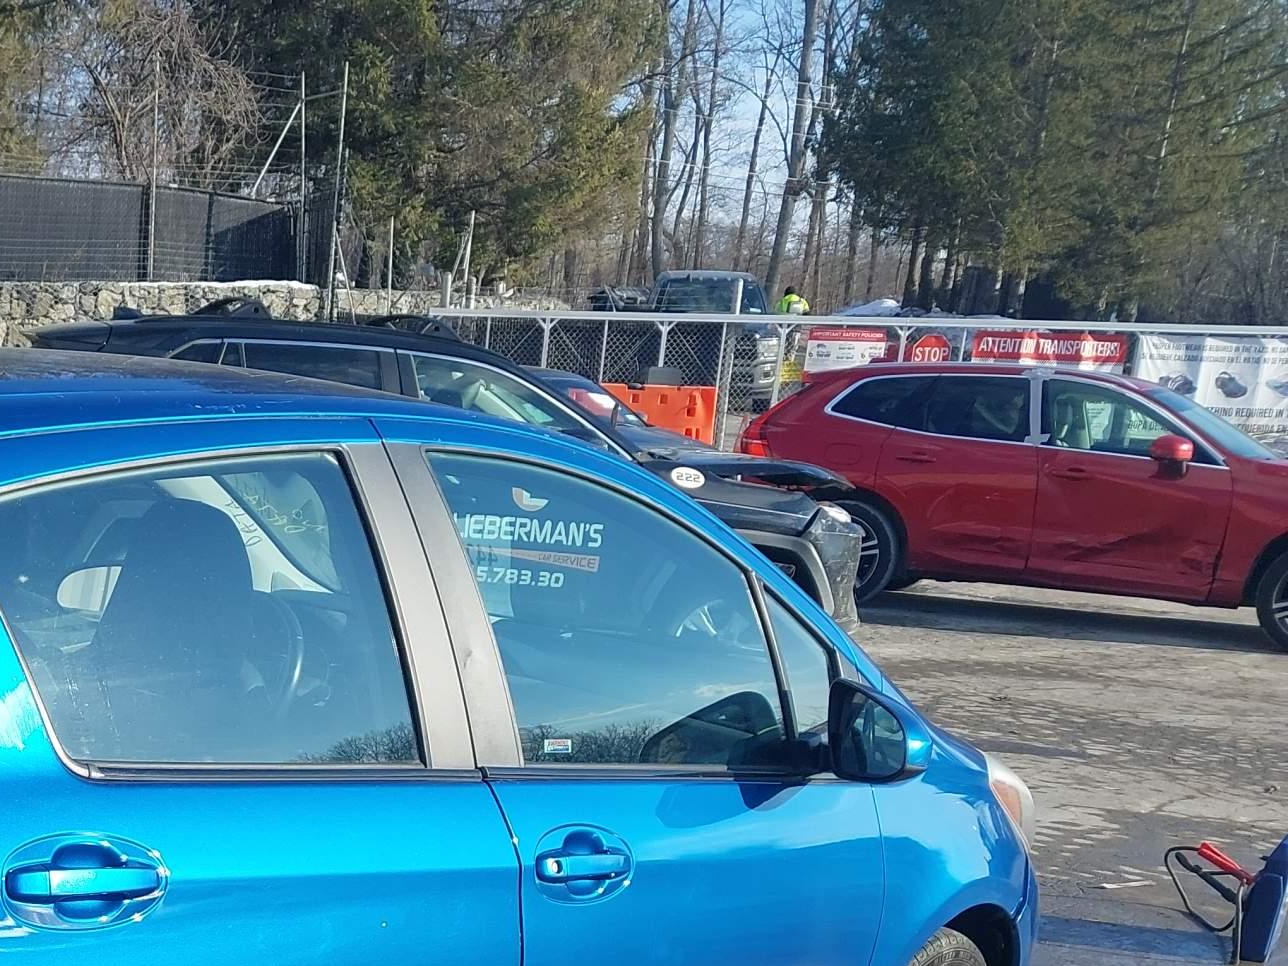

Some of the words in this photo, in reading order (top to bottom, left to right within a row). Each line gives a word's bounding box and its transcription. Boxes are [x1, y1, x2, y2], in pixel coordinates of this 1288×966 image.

[914, 346, 949, 362] STOP
[978, 336, 1034, 353] ATTENTION
[1038, 338, 1120, 357] TRANSPORTERS!
[1235, 407, 1274, 418] REQUIRED
[1275, 408, 1284, 418] IN
[675, 471, 702, 483] 222
[553, 554, 598, 570] SERVICE
